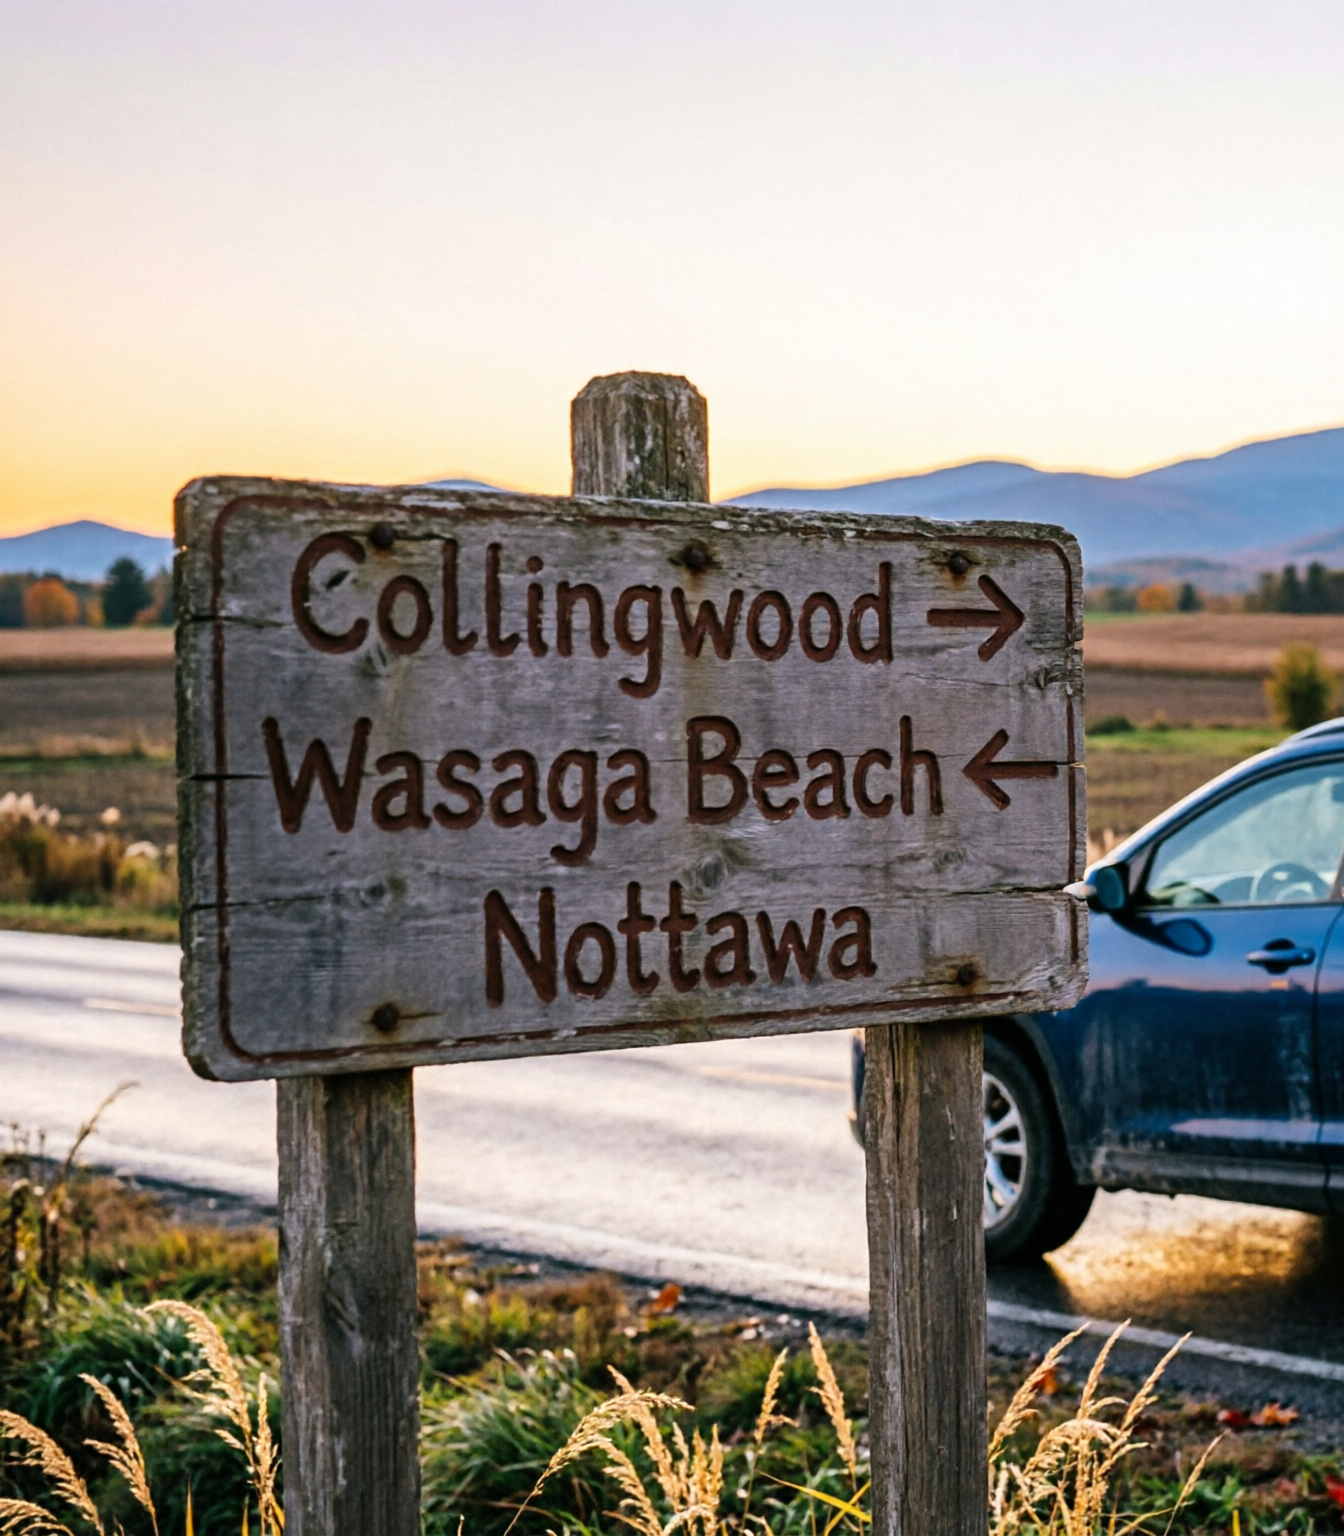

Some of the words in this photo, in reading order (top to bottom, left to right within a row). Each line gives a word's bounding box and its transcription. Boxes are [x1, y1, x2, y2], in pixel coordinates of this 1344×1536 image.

[292, 532, 894, 698] Collingwood
[261, 716, 656, 865] Wasaga
[687, 714, 944, 825] Beach
[483, 880, 878, 1008] Nottawa
